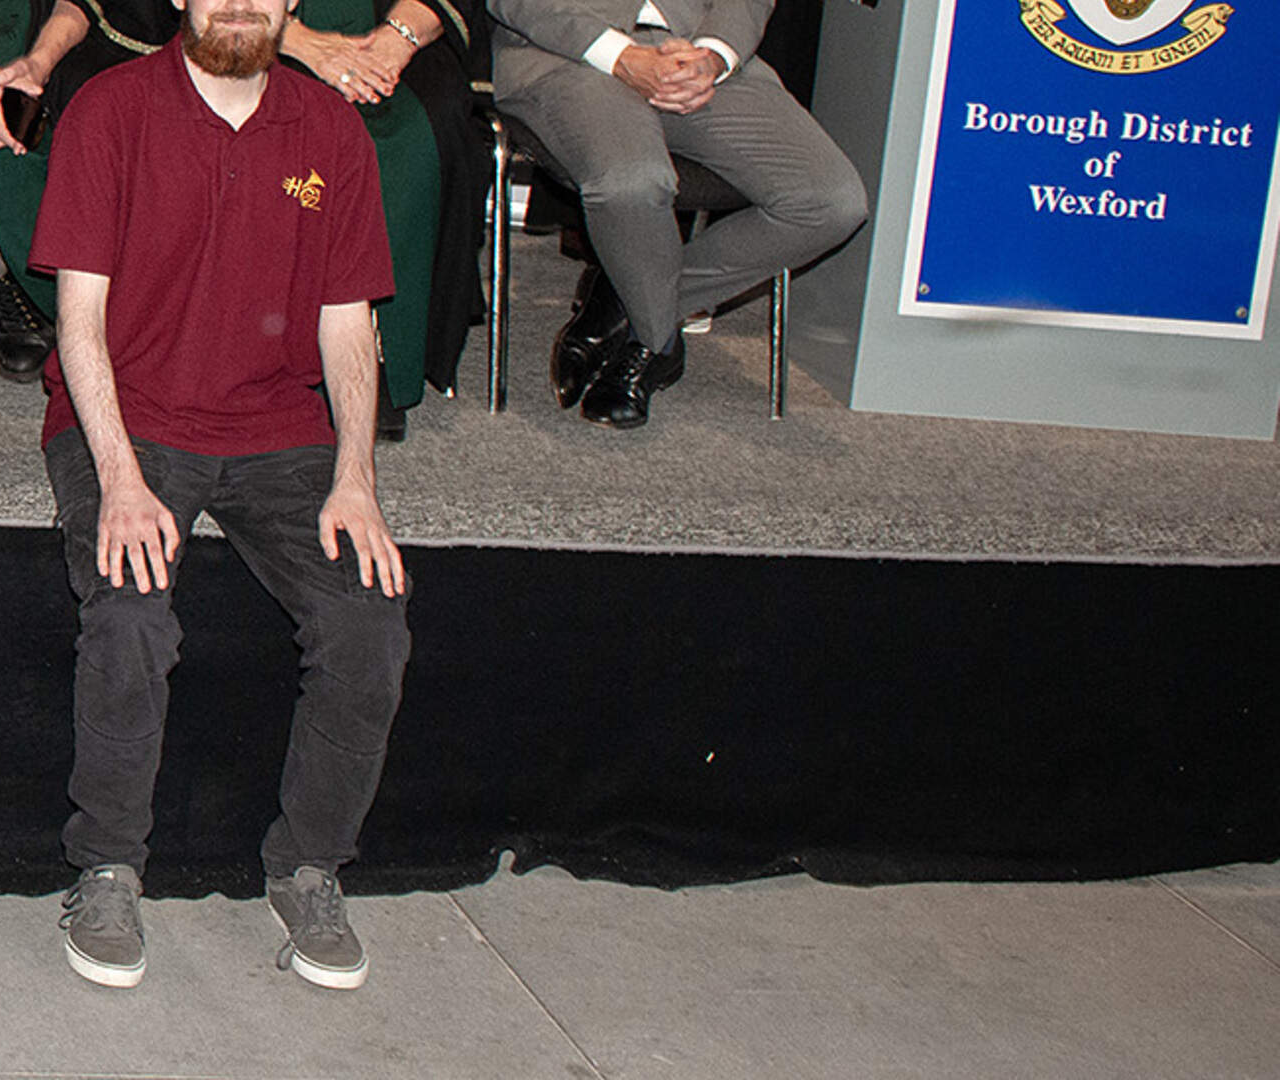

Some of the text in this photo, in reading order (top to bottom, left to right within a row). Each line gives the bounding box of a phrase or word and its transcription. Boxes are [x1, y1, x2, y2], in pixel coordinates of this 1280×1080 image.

[1029, 15, 1055, 42] PER
[1120, 54, 1143, 71] ET
[963, 101, 1253, 148] Borough District
[1083, 150, 1122, 178] of
[1028, 184, 1168, 220] Wexford
